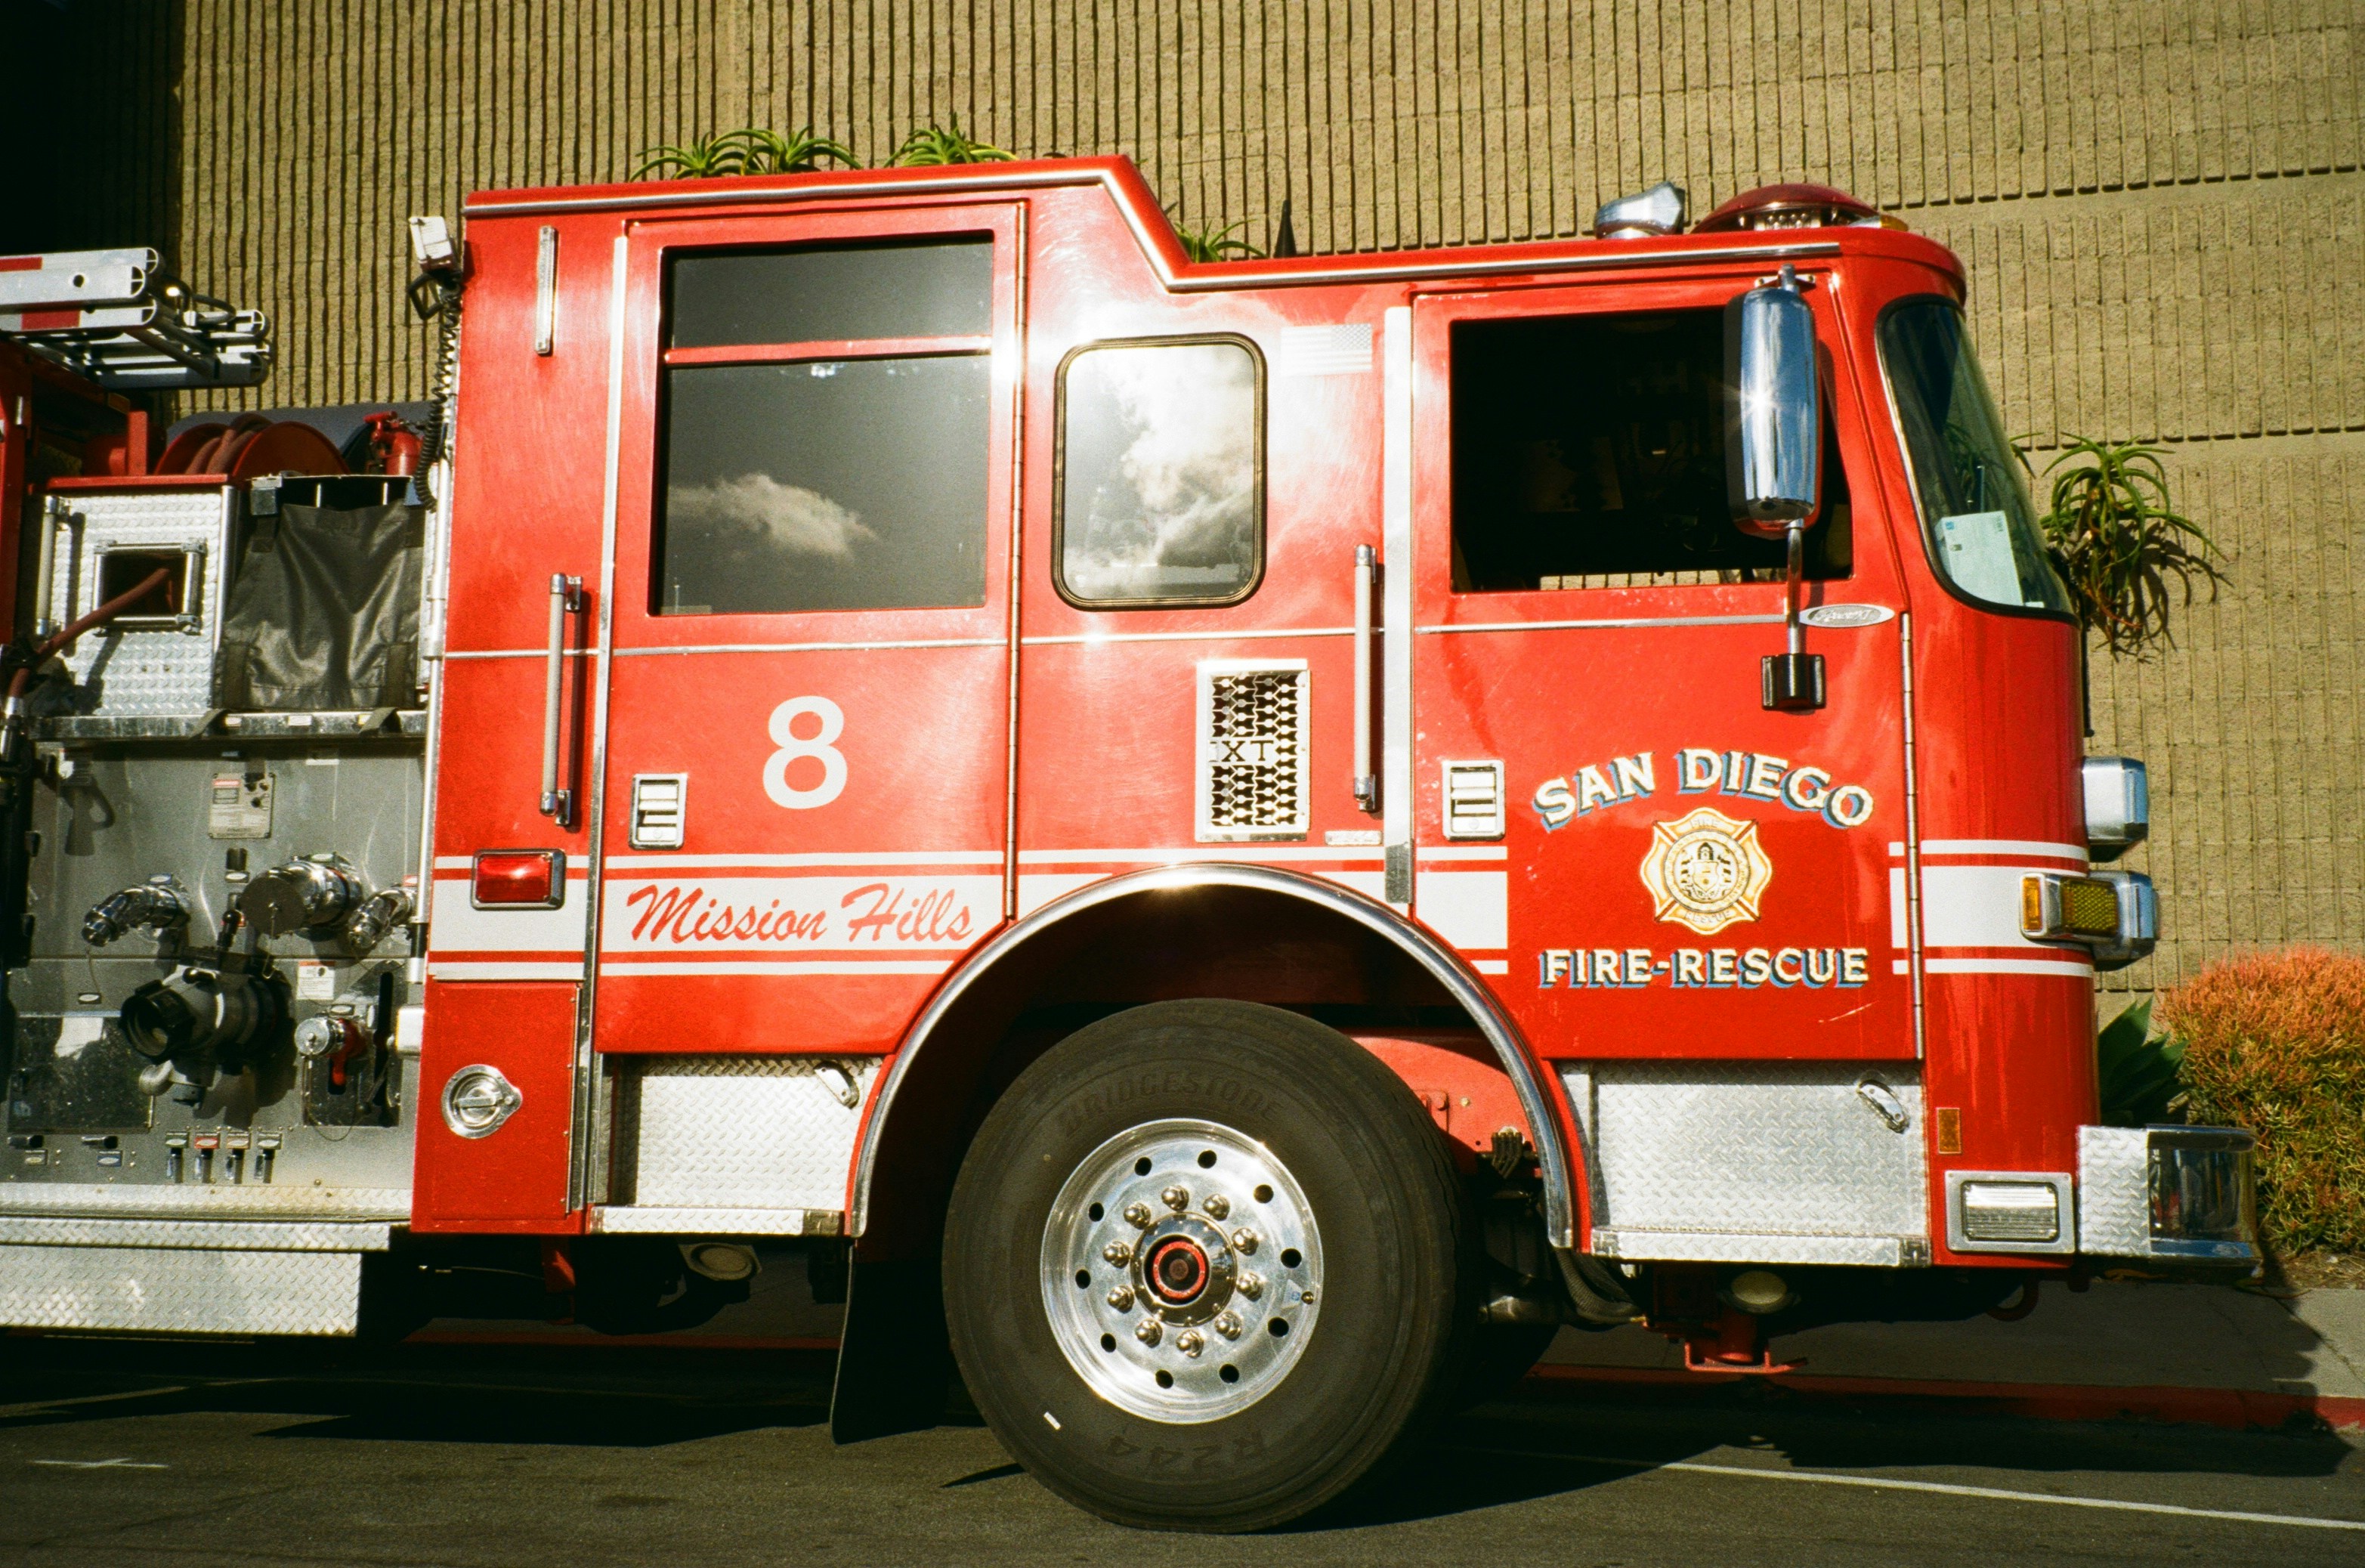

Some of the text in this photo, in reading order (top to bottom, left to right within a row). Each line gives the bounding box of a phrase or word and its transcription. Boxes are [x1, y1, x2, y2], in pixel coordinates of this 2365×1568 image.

[763, 696, 847, 809] 8
[1532, 748, 1874, 830] SAN DIEGO
[626, 883, 974, 944] Mission Hills
[1540, 947, 1869, 988] FIRE-RESCUE
